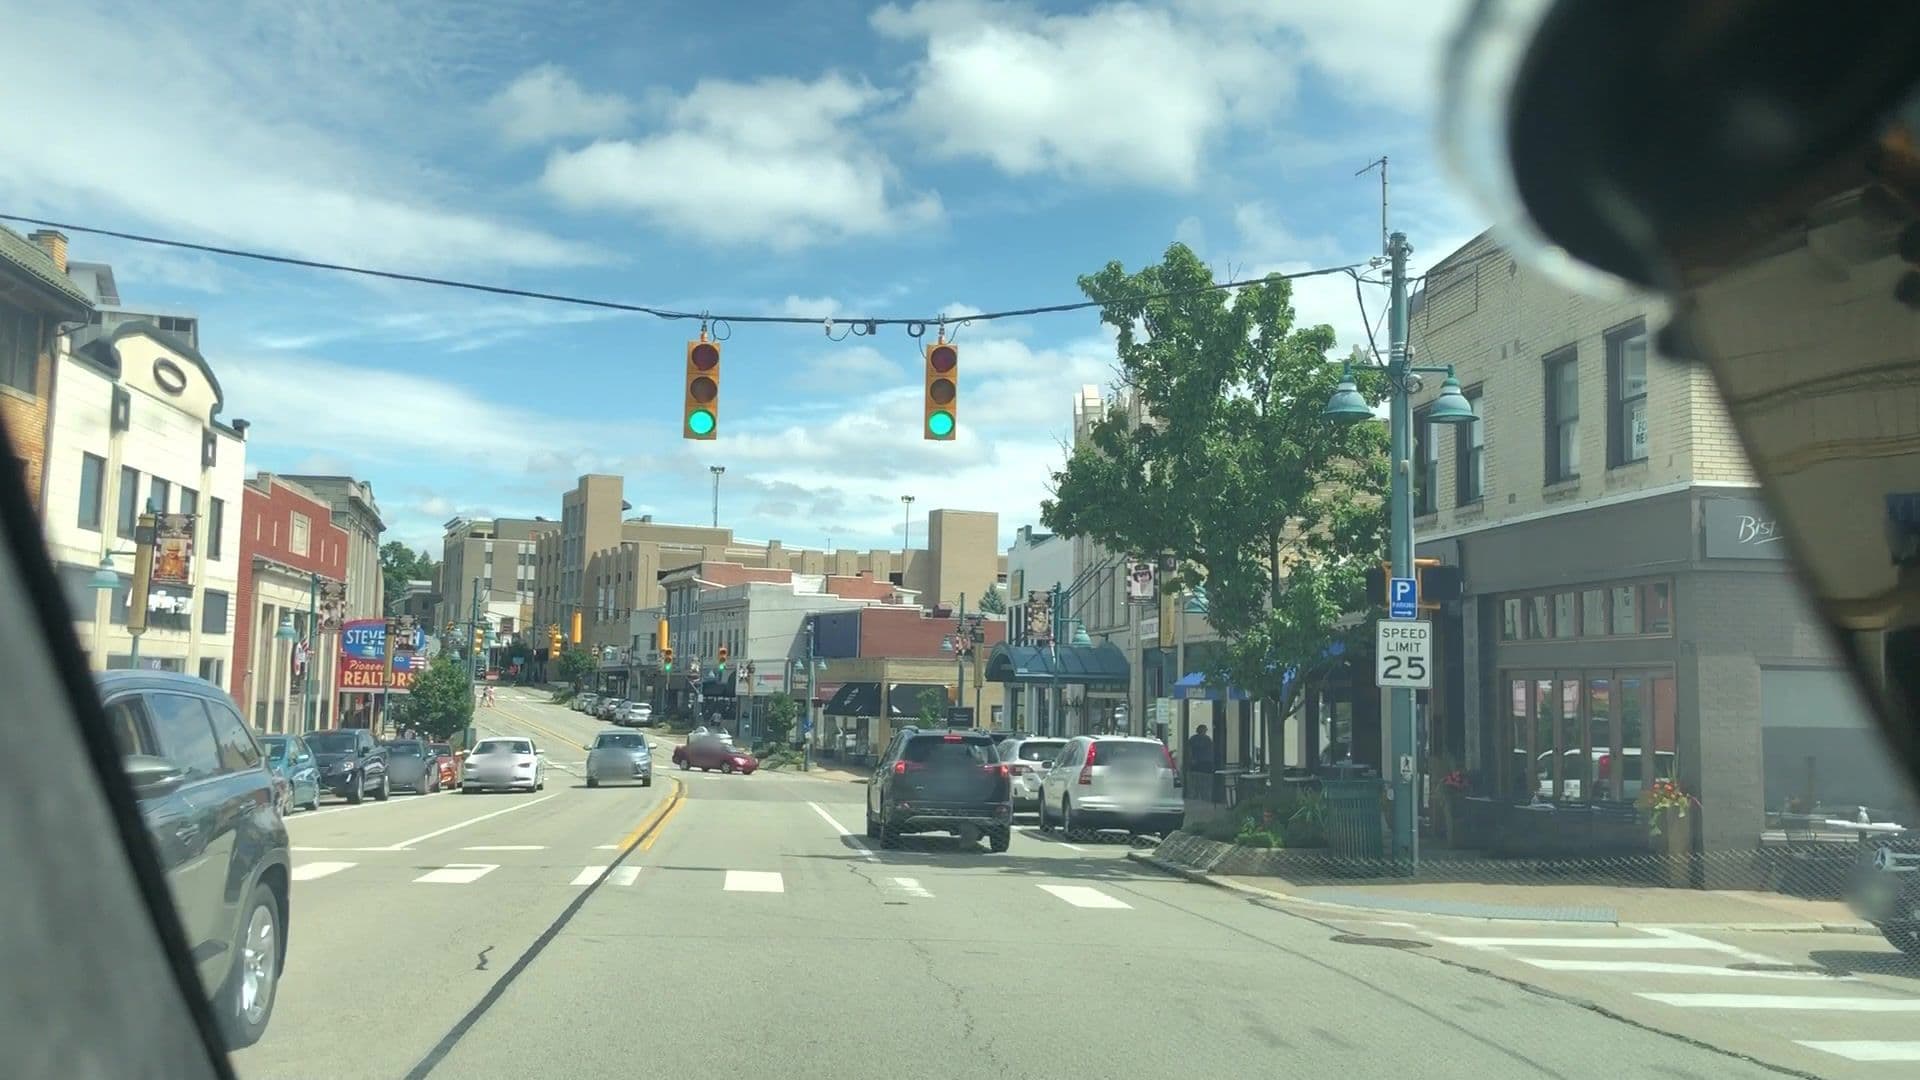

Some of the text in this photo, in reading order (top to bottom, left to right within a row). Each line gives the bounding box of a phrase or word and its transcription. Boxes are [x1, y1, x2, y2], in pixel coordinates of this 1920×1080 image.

[1736, 515, 1776, 544] Bist
[1396, 581, 1410, 601] P
[1382, 628, 1427, 639] SPEED
[1387, 642, 1421, 652] LIMIT
[1383, 655, 1425, 680] 25
